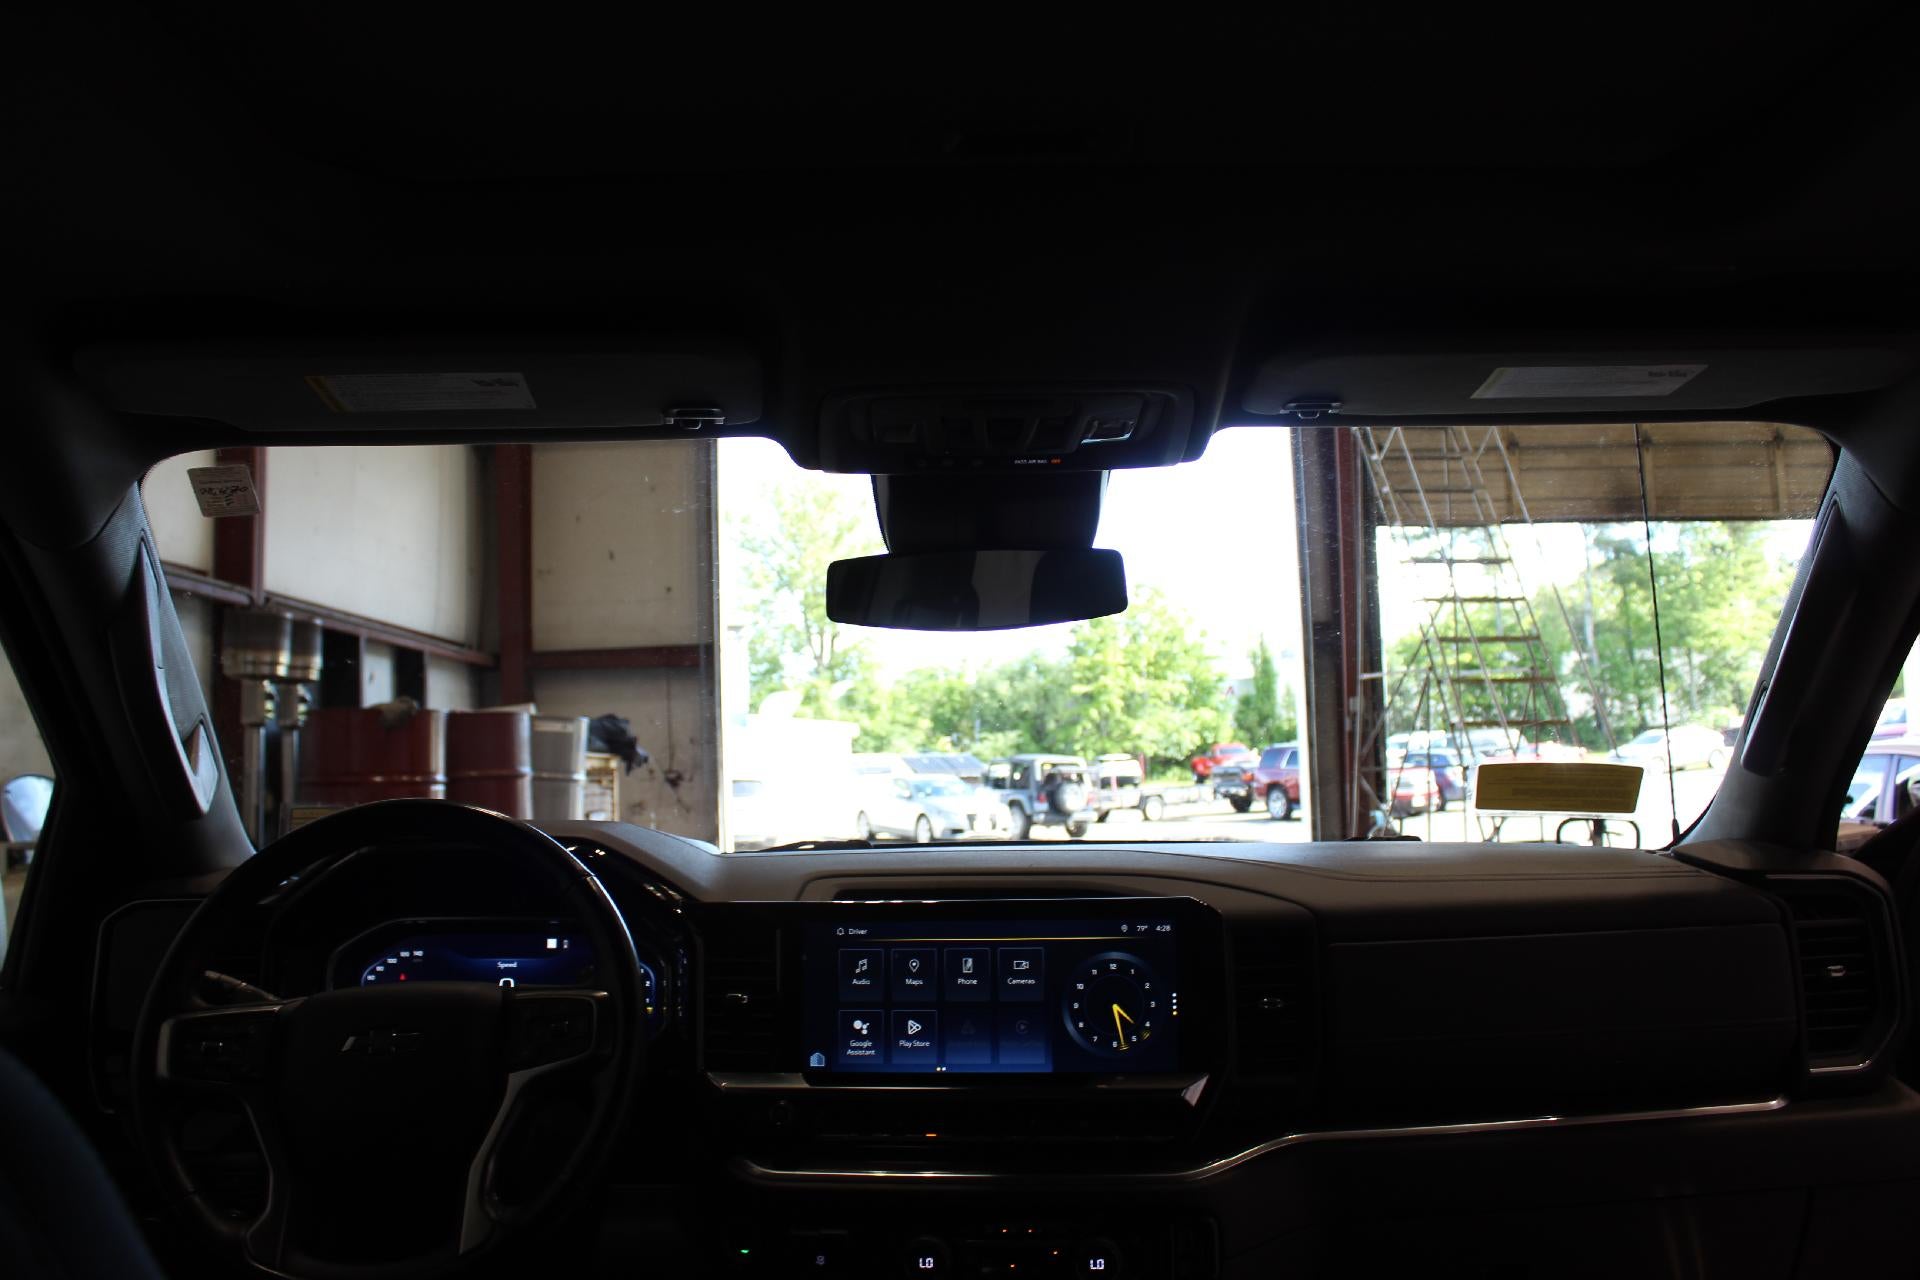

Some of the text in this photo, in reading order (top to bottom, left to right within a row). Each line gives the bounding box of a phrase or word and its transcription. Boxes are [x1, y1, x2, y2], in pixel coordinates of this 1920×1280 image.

[497, 961, 518, 970] Speed
[905, 978, 923, 986] Maps
[1007, 977, 1036, 985] Cameras
[849, 1040, 872, 1049] Google
[899, 1040, 912, 1049] Play
